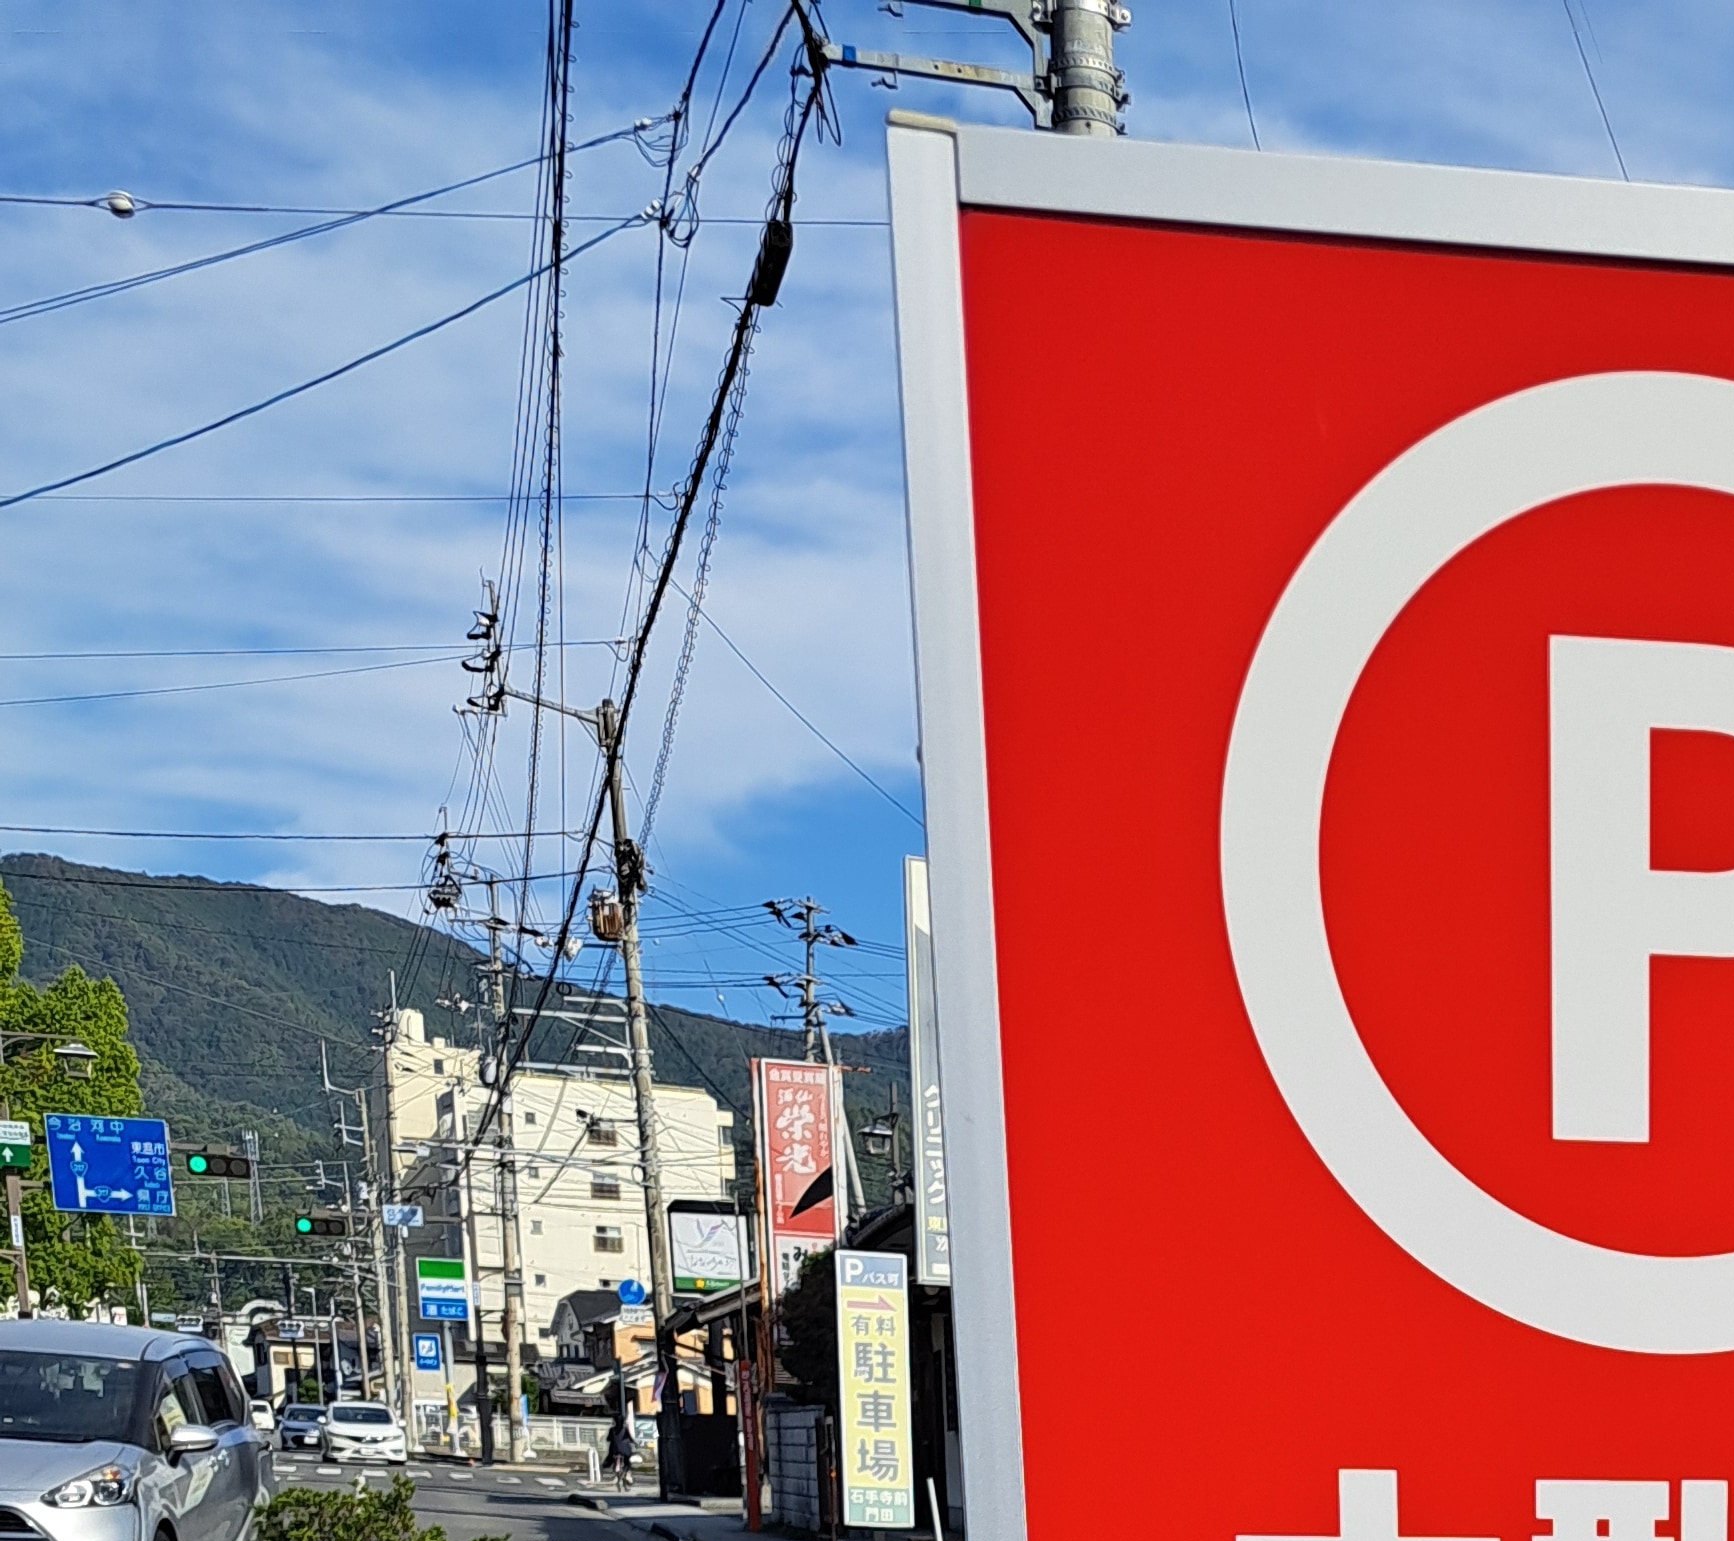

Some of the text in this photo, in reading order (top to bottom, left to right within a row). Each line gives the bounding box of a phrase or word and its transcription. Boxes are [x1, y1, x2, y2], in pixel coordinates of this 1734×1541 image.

[844, 1257, 899, 1287] P バス可
[850, 1314, 896, 1337] 有料
[853, 1341, 899, 1482] 駐車場
[850, 1489, 908, 1507] 石手寺前
